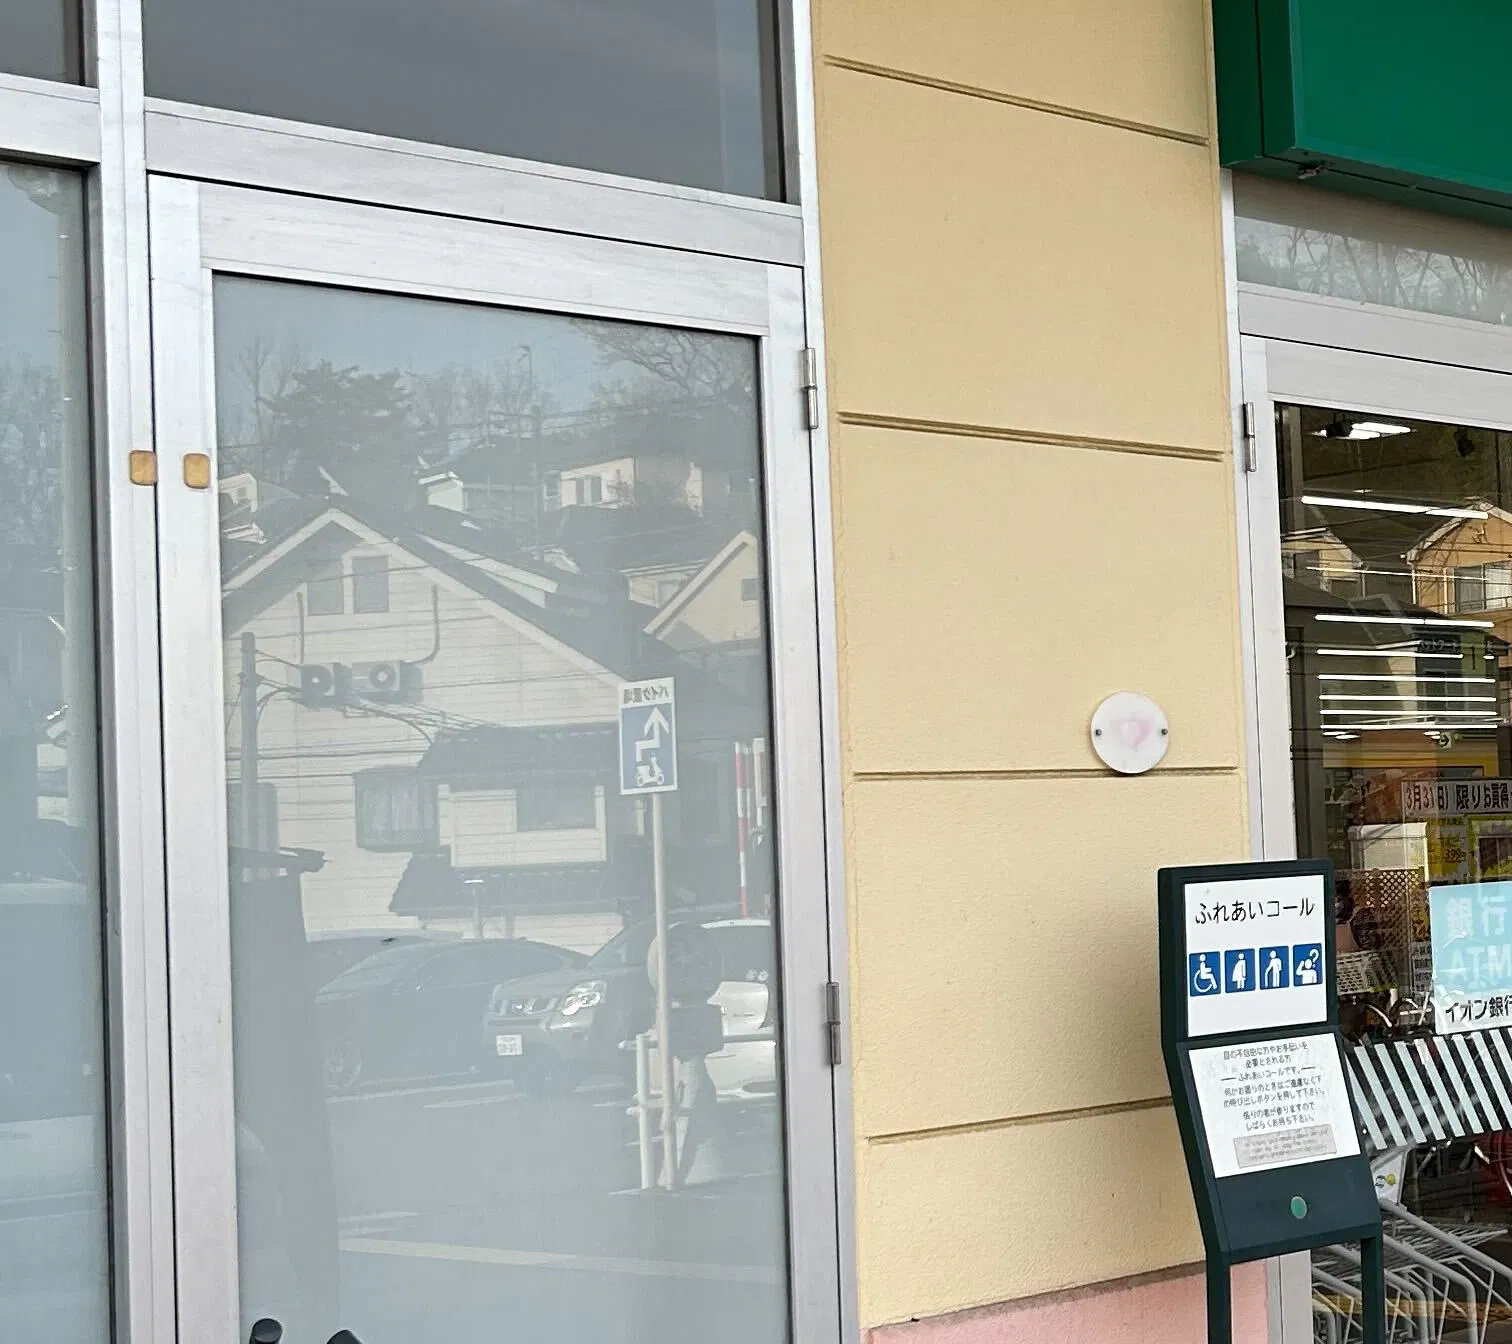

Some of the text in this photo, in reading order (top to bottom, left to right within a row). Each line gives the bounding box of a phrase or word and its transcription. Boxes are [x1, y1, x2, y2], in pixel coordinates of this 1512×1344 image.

[1195, 896, 1315, 924] ふれあいコール
[1451, 943, 1512, 987] ATM
